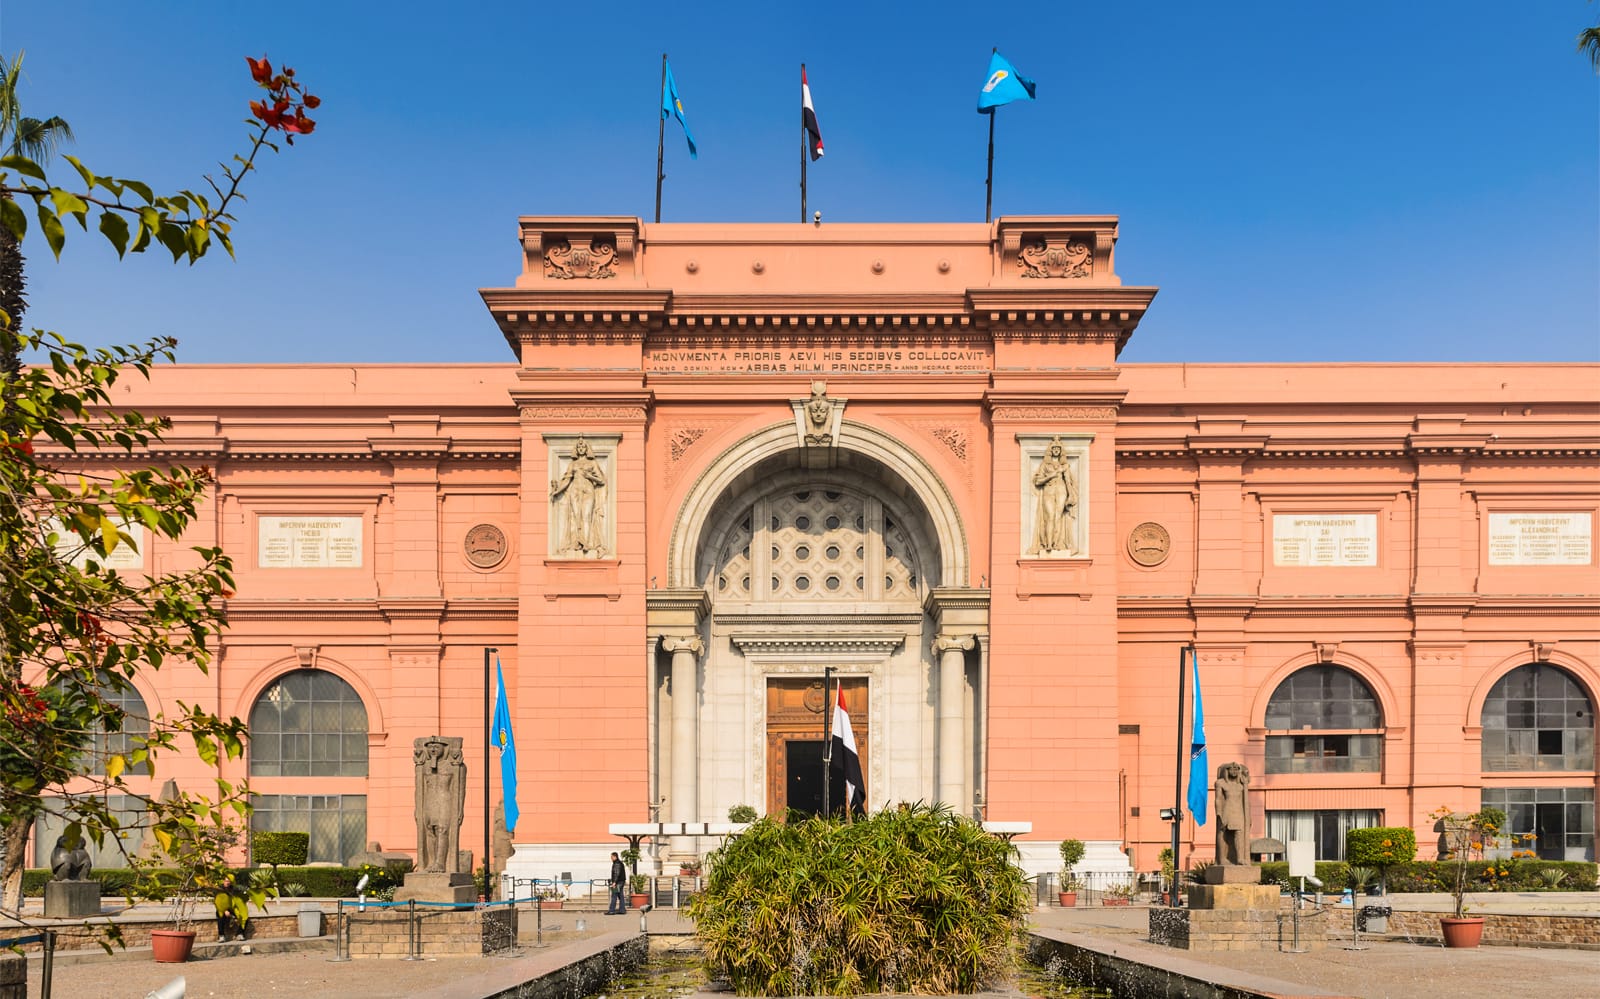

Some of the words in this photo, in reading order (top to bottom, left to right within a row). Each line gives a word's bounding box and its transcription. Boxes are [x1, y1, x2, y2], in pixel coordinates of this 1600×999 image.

[653, 352, 727, 361] MONVMENTA
[734, 352, 781, 361] PRIORIS
[789, 352, 816, 361] AEVI
[823, 352, 842, 361] HIS
[849, 352, 902, 361] SEDIBVS
[909, 351, 984, 361] COLLOCAVIT
[746, 363, 787, 372] ABBAS
[794, 363, 824, 372] HILMI
[831, 363, 892, 372] PRINCEPS
